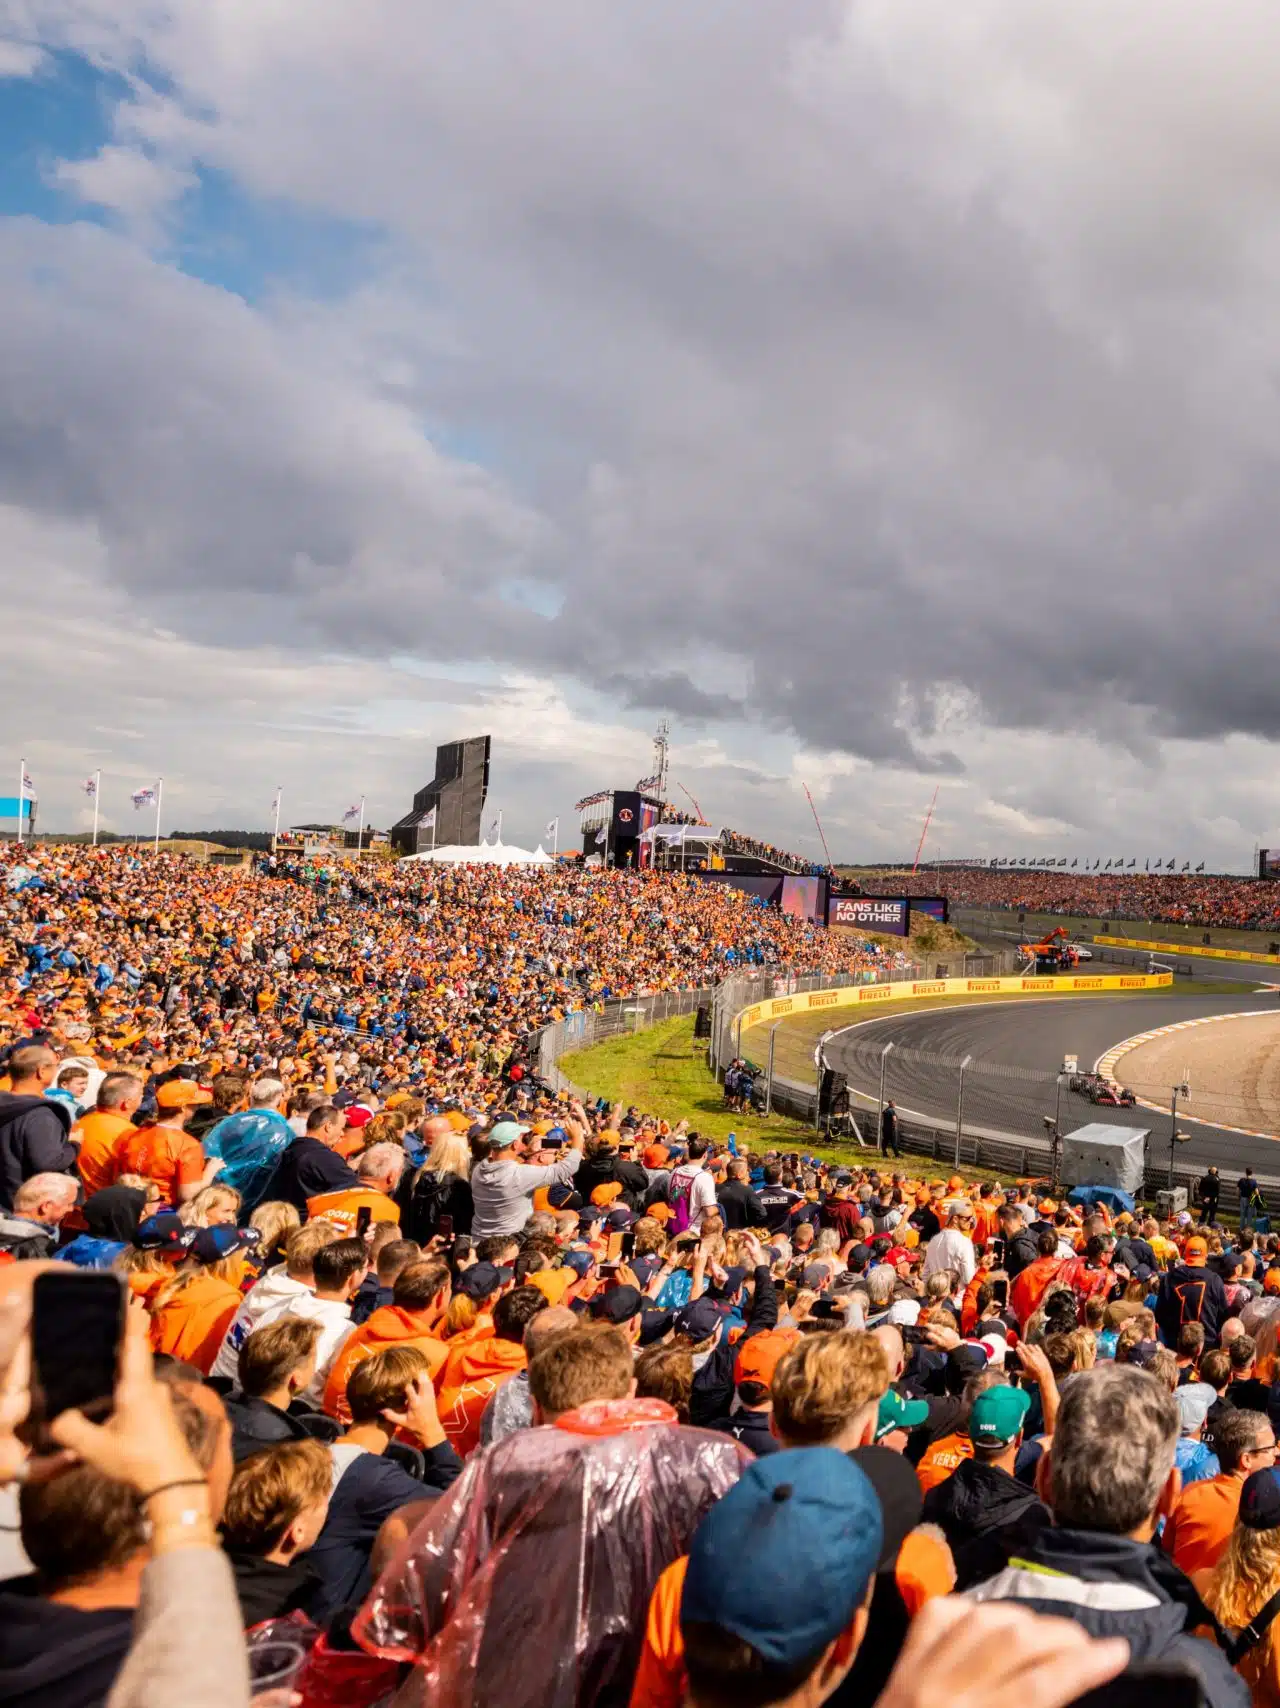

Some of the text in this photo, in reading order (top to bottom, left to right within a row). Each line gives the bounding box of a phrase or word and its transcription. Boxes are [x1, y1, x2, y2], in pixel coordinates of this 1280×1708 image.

[836, 902, 901, 913] FANS LIKE
[836, 912, 900, 923] NO OTHER
[913, 982, 946, 994] PIRELLI
[967, 980, 1000, 991] PIRELLI
[1022, 979, 1054, 990] PIRELLI
[1074, 978, 1103, 989] PIRELLI
[859, 986, 891, 1000] PIRELLI
[808, 992, 838, 1007] PIRELLI
[1175, 1281, 1206, 1324] 1
